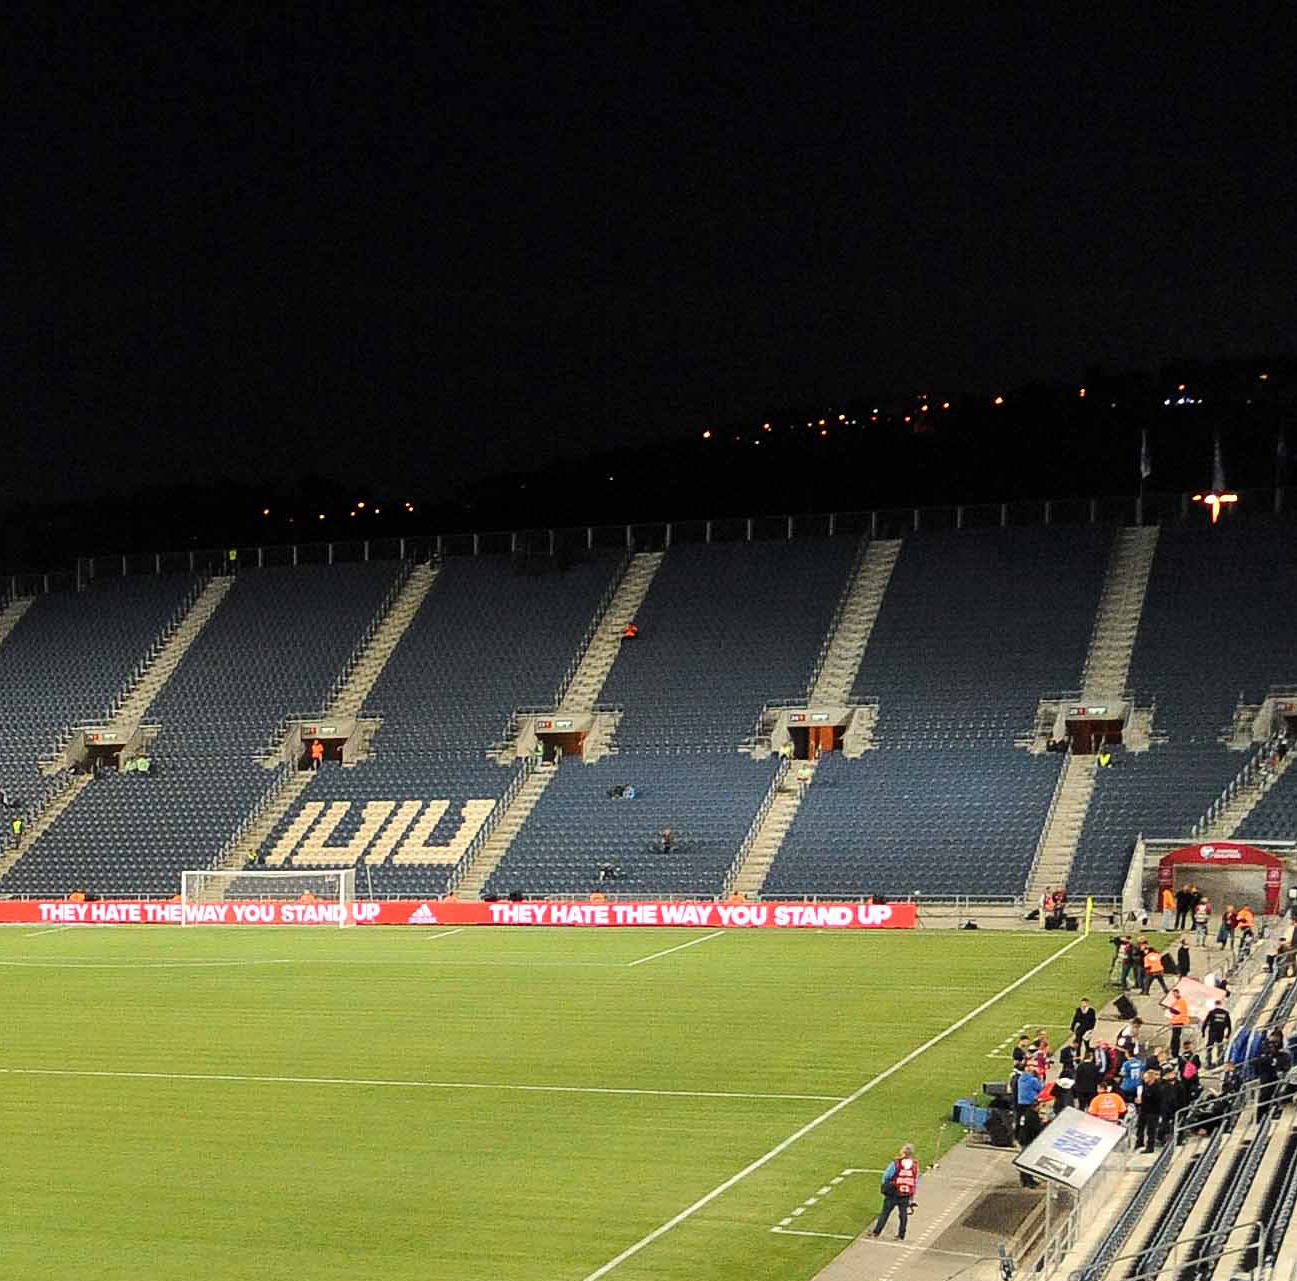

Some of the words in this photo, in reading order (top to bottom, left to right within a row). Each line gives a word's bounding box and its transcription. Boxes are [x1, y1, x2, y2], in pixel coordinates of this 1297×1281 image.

[40, 903, 88, 921] THEY
[91, 903, 140, 921] HATE
[143, 903, 183, 921] THE
[184, 903, 230, 921] WAY
[232, 904, 276, 921] YOU
[280, 904, 347, 922] STAND
[353, 903, 380, 921] UP
[490, 904, 548, 923] THEY
[551, 904, 609, 923] HATE
[612, 905, 659, 924] THE
[661, 905, 716, 924] WAY
[718, 905, 767, 925] YOU
[773, 905, 853, 925] STAND
[858, 904, 893, 924] UP
